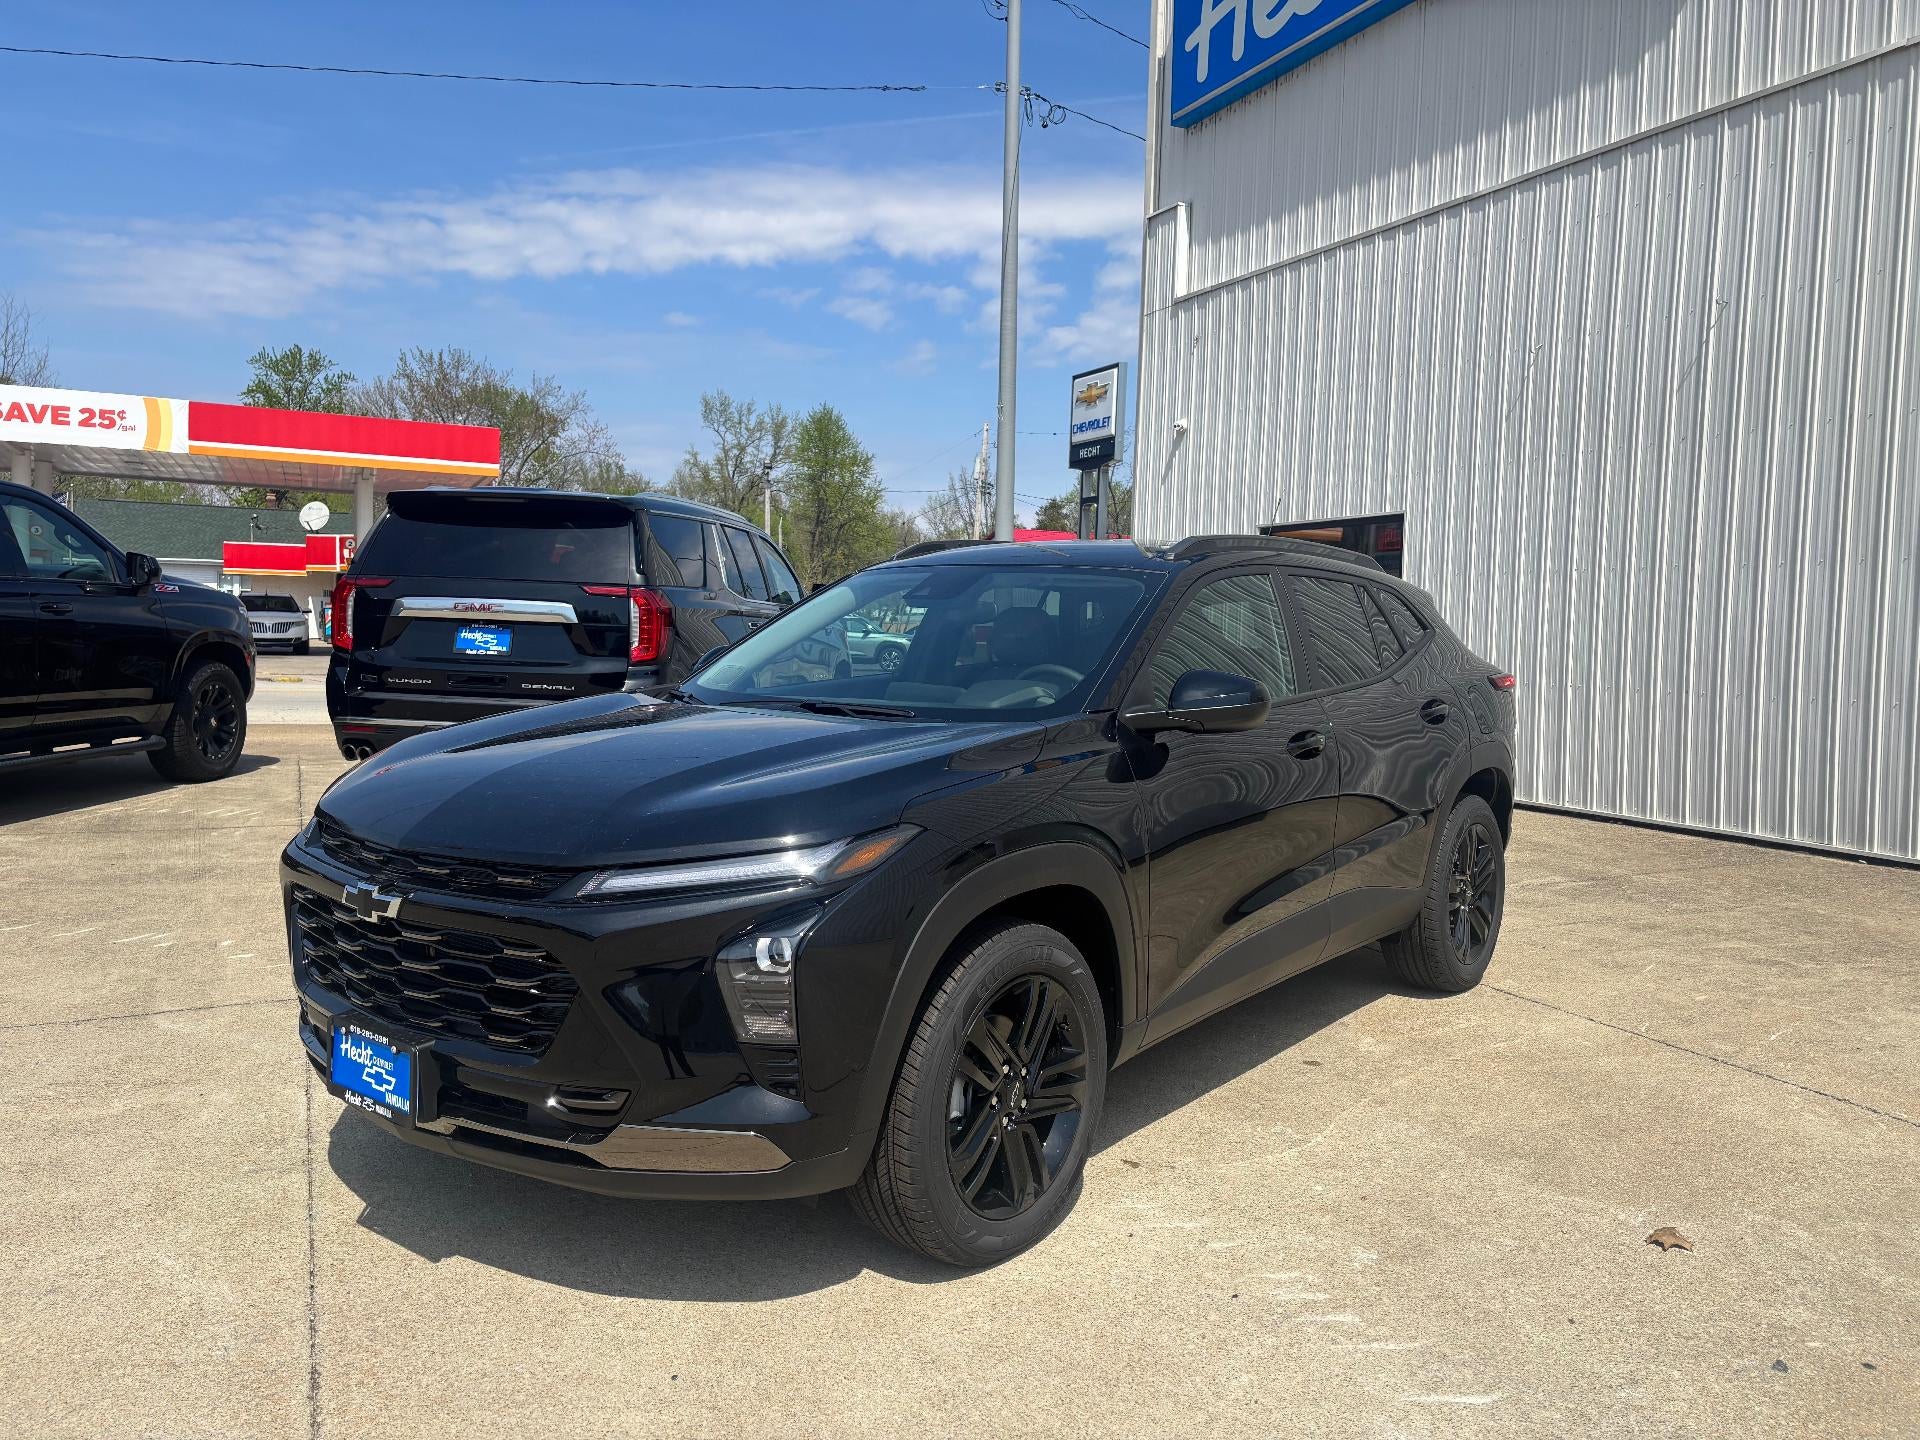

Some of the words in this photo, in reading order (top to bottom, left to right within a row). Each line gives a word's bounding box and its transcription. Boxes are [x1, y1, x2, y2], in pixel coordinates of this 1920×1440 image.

[0, 401, 71, 426] AVE
[1072, 416, 1111, 435] CHEVROLET
[1079, 445, 1101, 459] HECHT
[454, 602, 504, 614] GMC
[387, 676, 432, 684] YUKON
[521, 682, 575, 691] DENALI
[340, 1033, 374, 1067] Hecht
